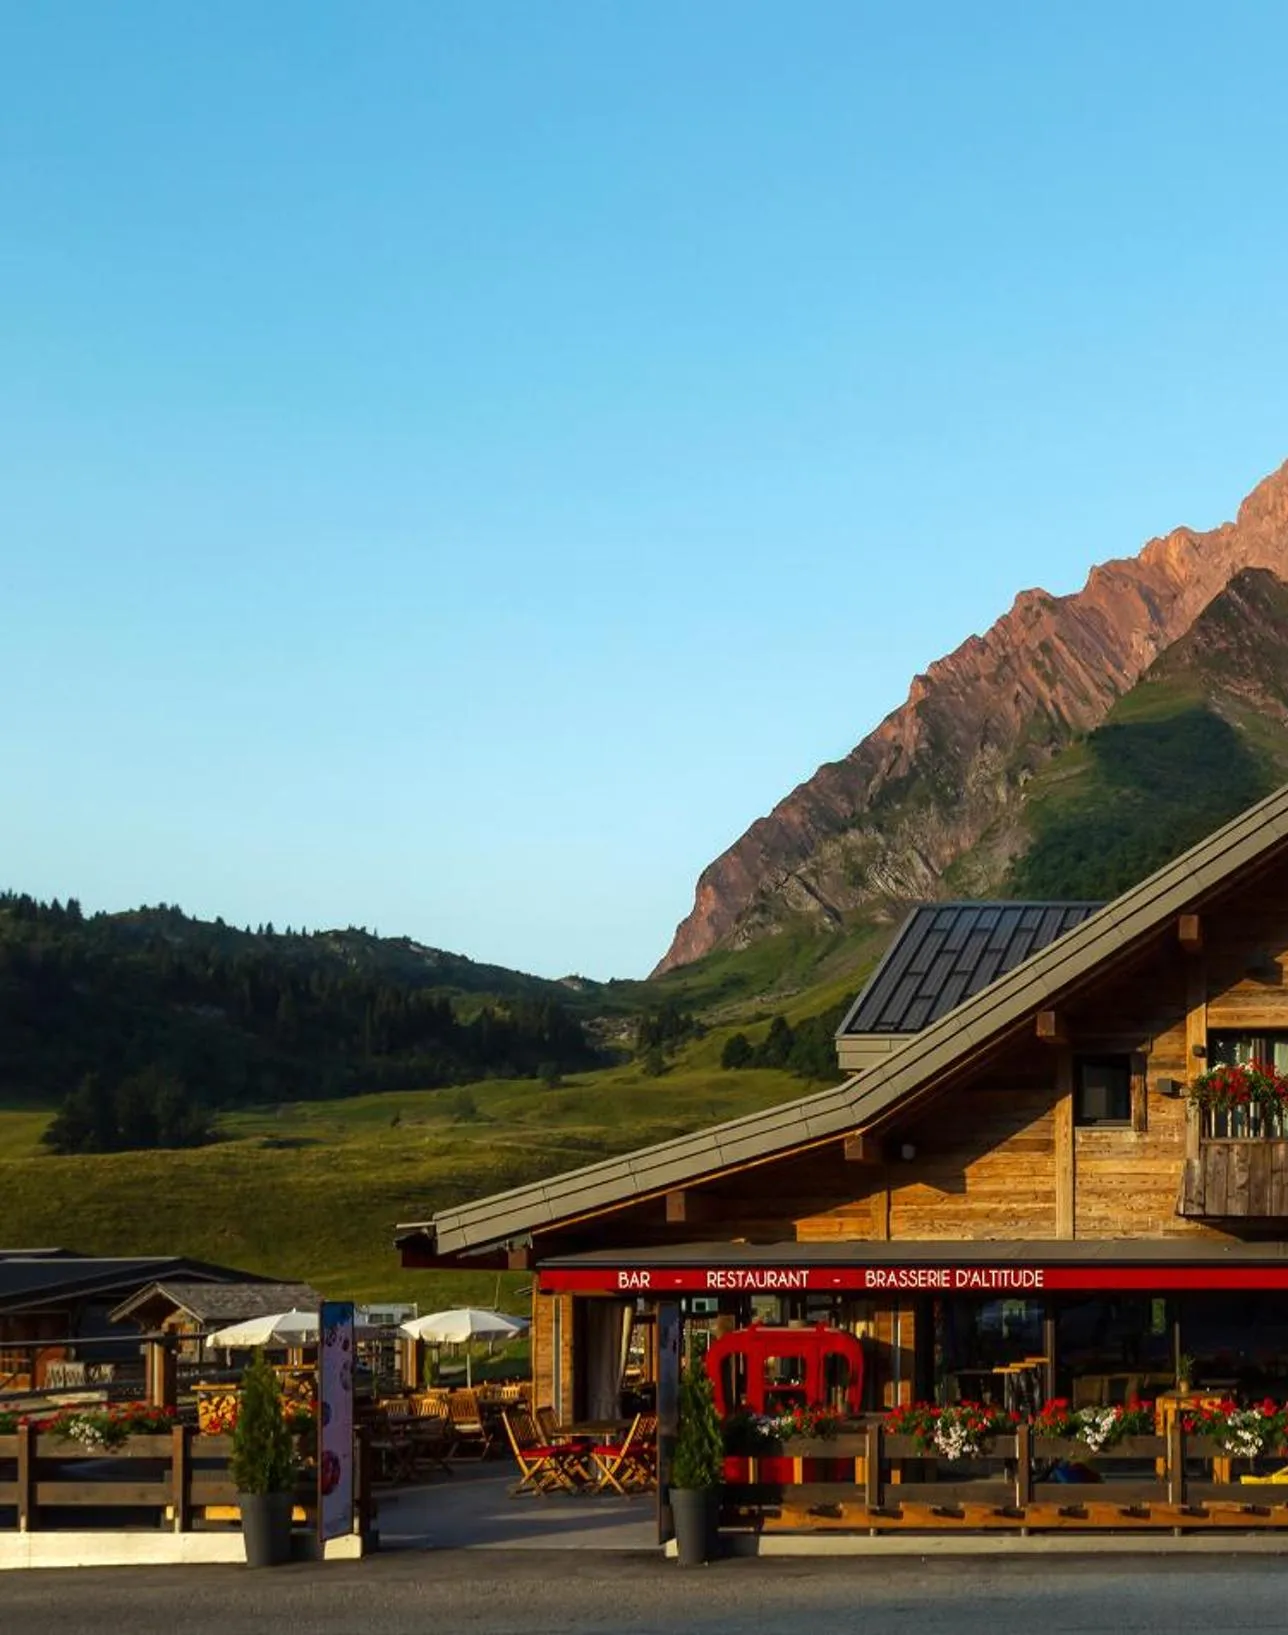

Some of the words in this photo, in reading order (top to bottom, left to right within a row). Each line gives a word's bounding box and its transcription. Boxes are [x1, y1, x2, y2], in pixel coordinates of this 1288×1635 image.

[618, 1271, 650, 1288] BAR
[706, 1270, 810, 1288] RESTAURANT
[865, 1269, 951, 1288] BRASSERIE
[955, 1269, 1044, 1288] D'ALTITUDE
